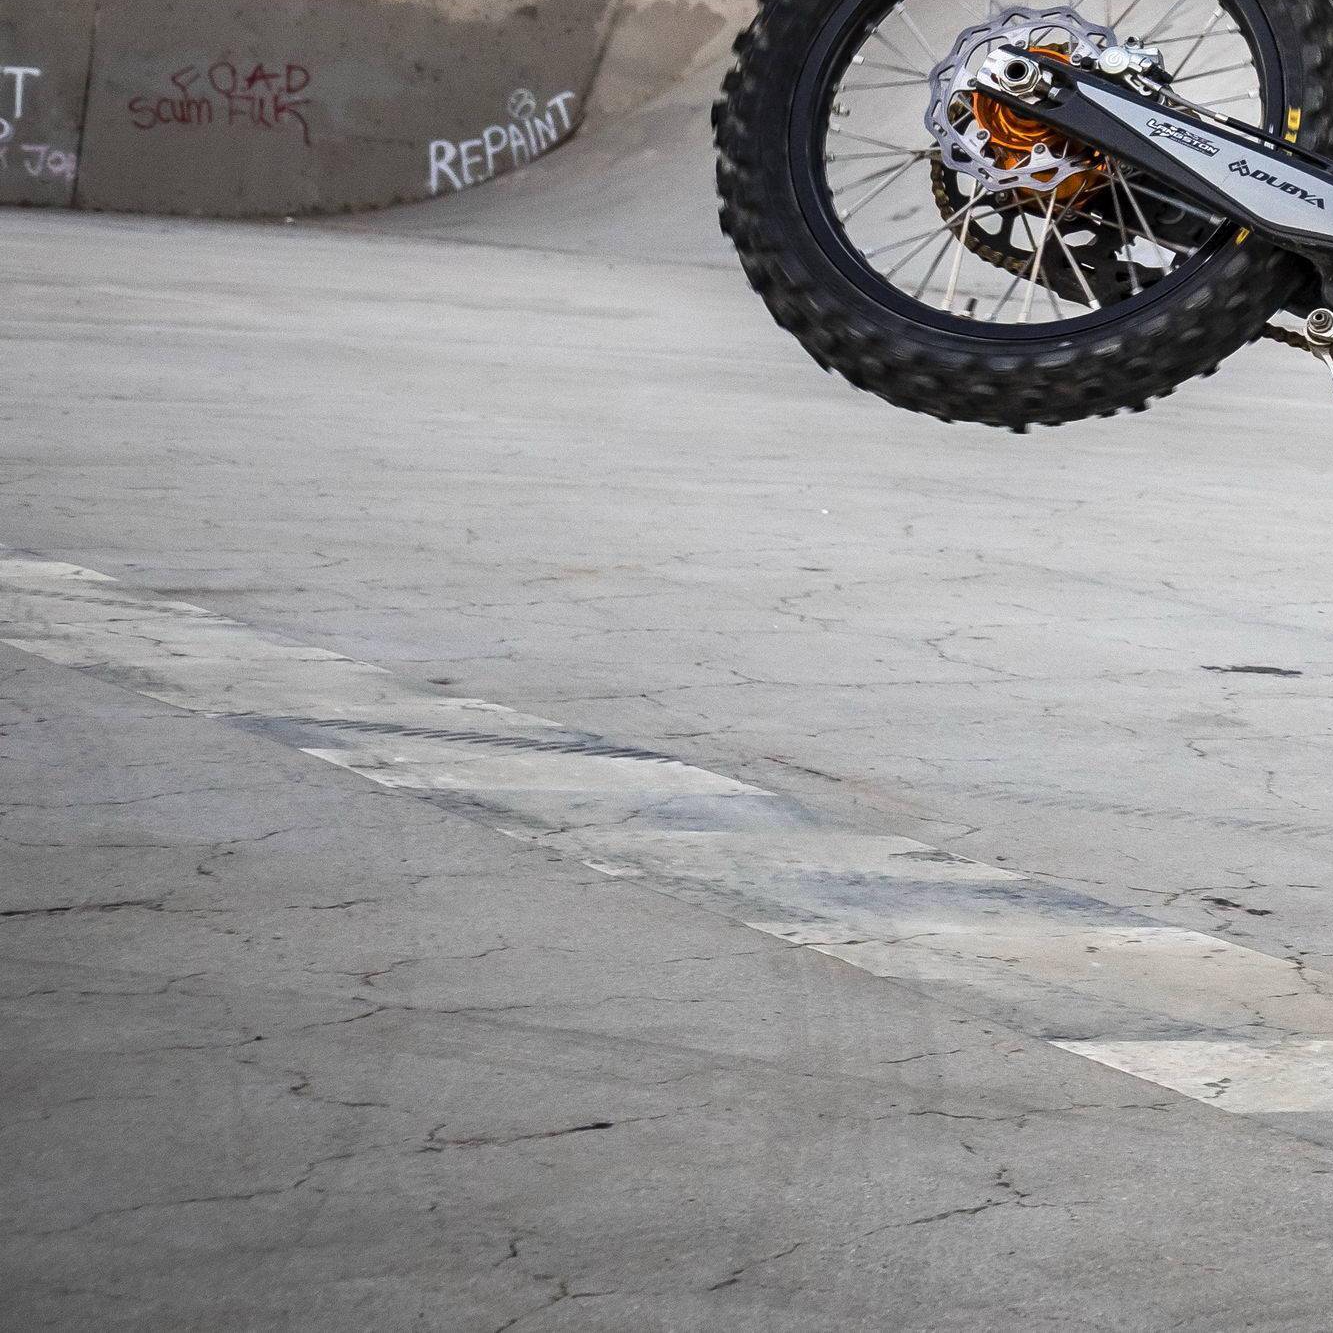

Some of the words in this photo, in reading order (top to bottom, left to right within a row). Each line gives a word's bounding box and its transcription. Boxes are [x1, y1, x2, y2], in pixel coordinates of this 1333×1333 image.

[427, 92, 575, 194] REPAINT
[1146, 118, 1219, 156] LANGSTON
[1250, 169, 1325, 210] DUBYA
